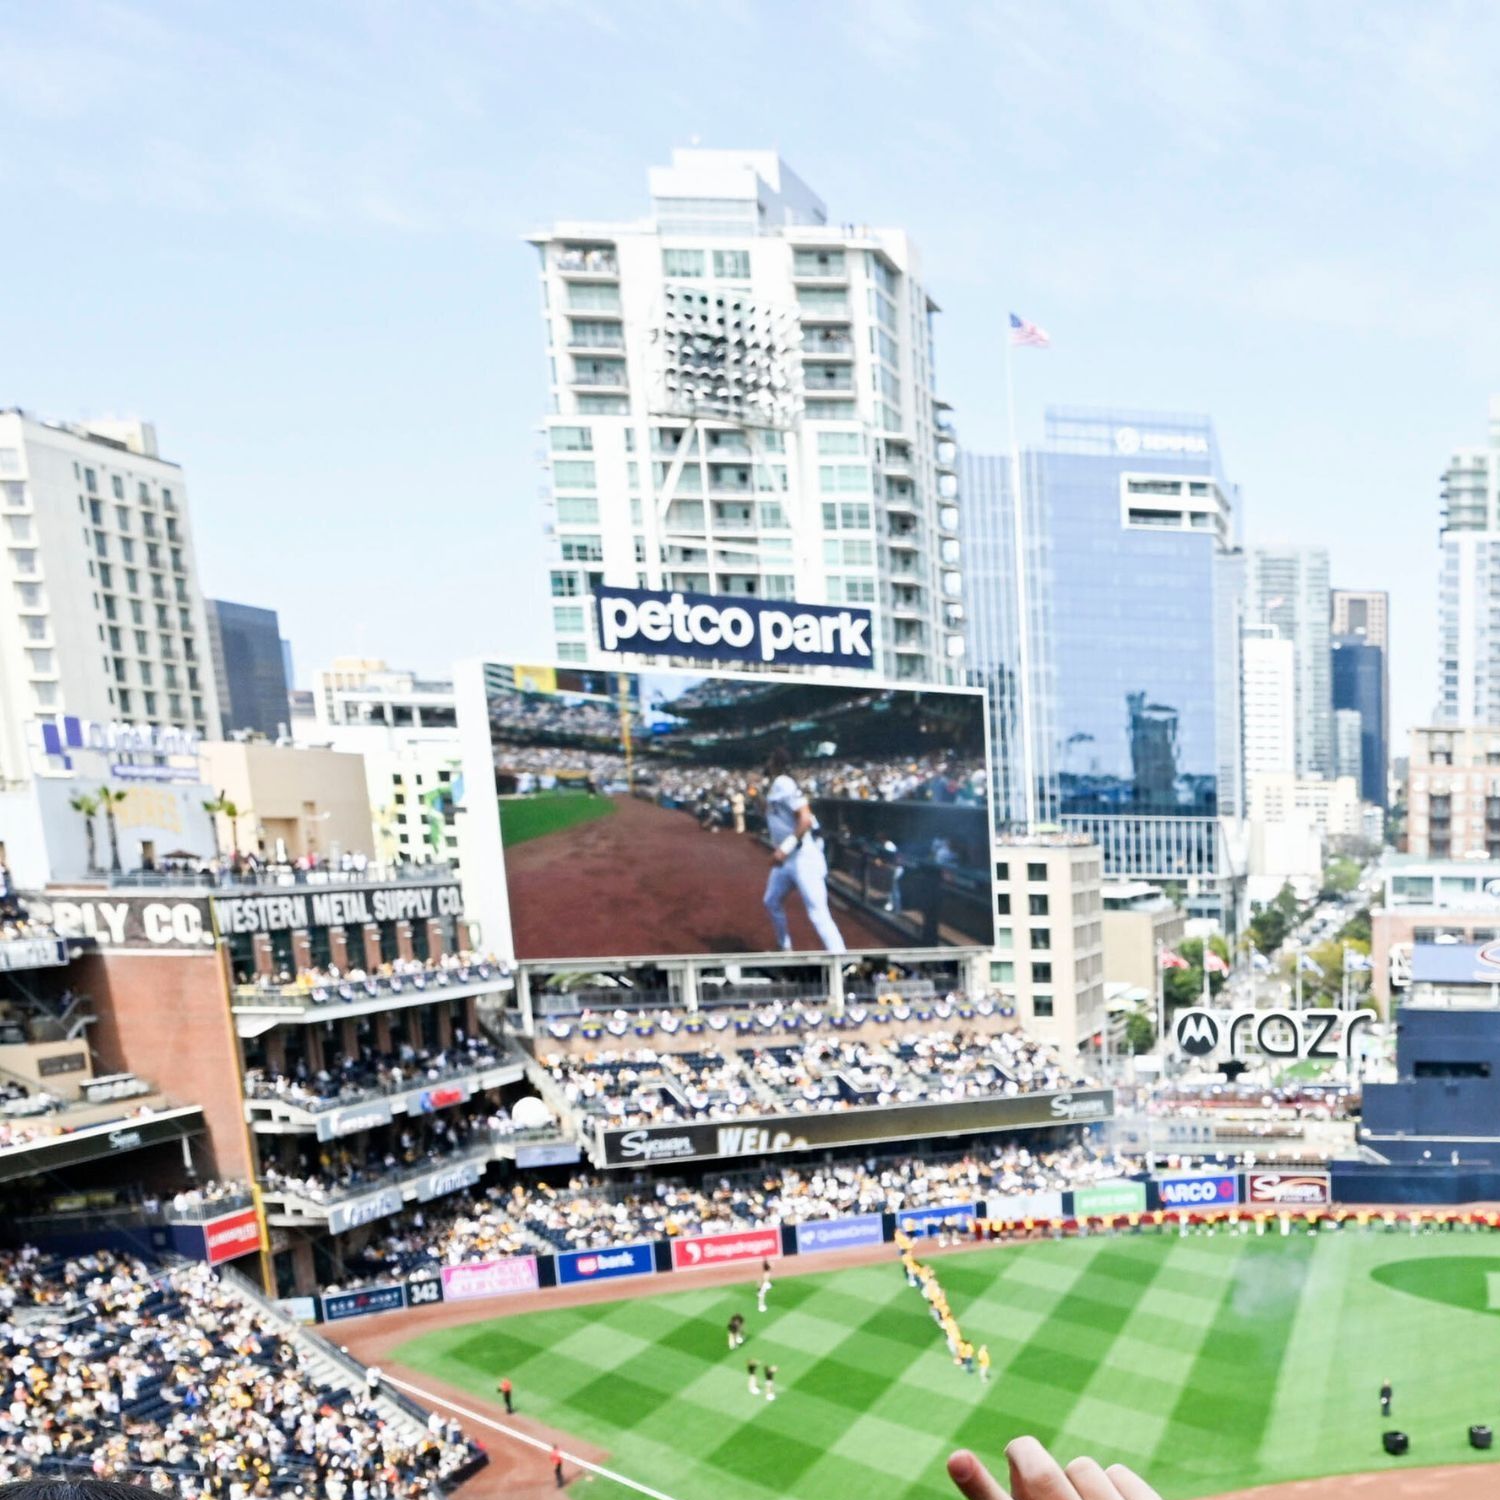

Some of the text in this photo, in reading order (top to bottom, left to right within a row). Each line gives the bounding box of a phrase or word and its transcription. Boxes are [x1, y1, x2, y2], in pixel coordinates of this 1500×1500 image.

[601, 593, 871, 661] petco park
[143, 903, 214, 944] CO.
[215, 886, 465, 933] WESTERN METAL SUPPLY CO.
[1230, 1013, 1371, 1057] razr
[1164, 1181, 1217, 1202] ARCO
[703, 1238, 776, 1259] Snapdragon
[410, 1283, 440, 1303] 342
